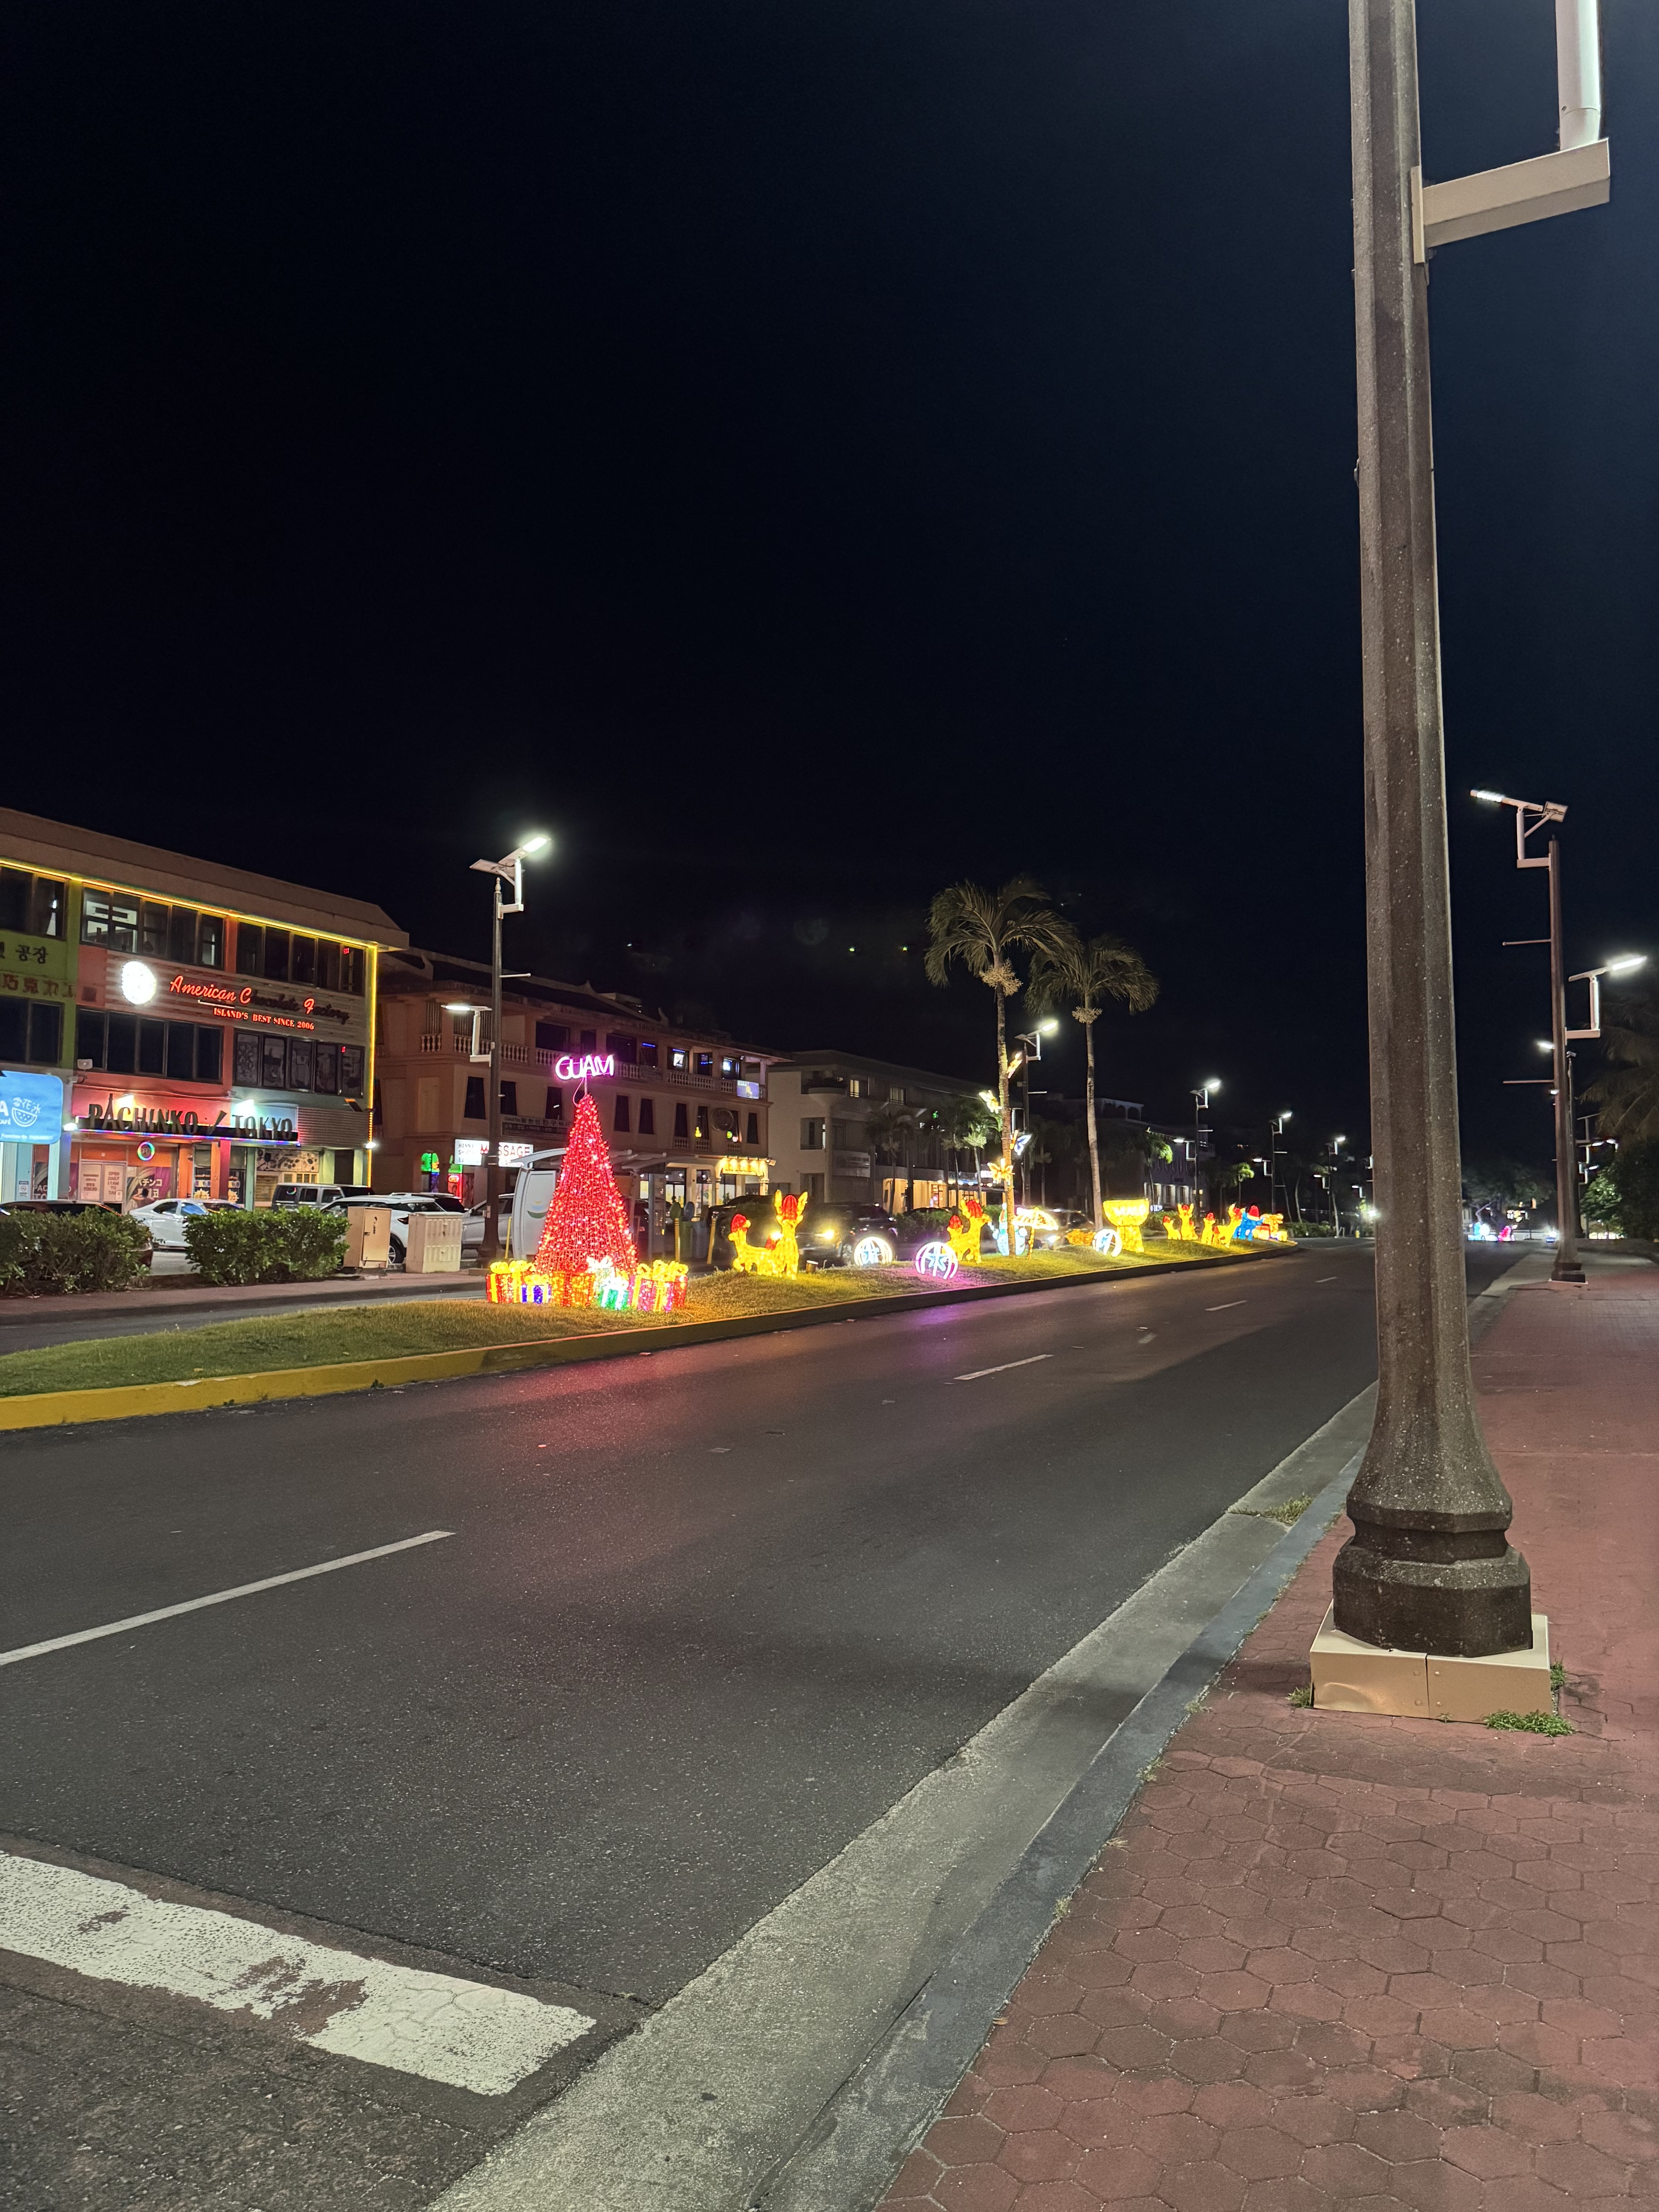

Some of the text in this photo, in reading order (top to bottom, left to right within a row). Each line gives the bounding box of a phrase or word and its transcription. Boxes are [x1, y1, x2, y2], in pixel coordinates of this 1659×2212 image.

[15, 945, 48, 964] 공장
[170, 975, 237, 1002] American
[213, 1007, 314, 1030] ISLAND'S BEST SINCE 2006
[555, 1054, 615, 1080] GUAM
[88, 1093, 199, 1135] PACHINKO
[232, 1115, 292, 1140] TOKYO
